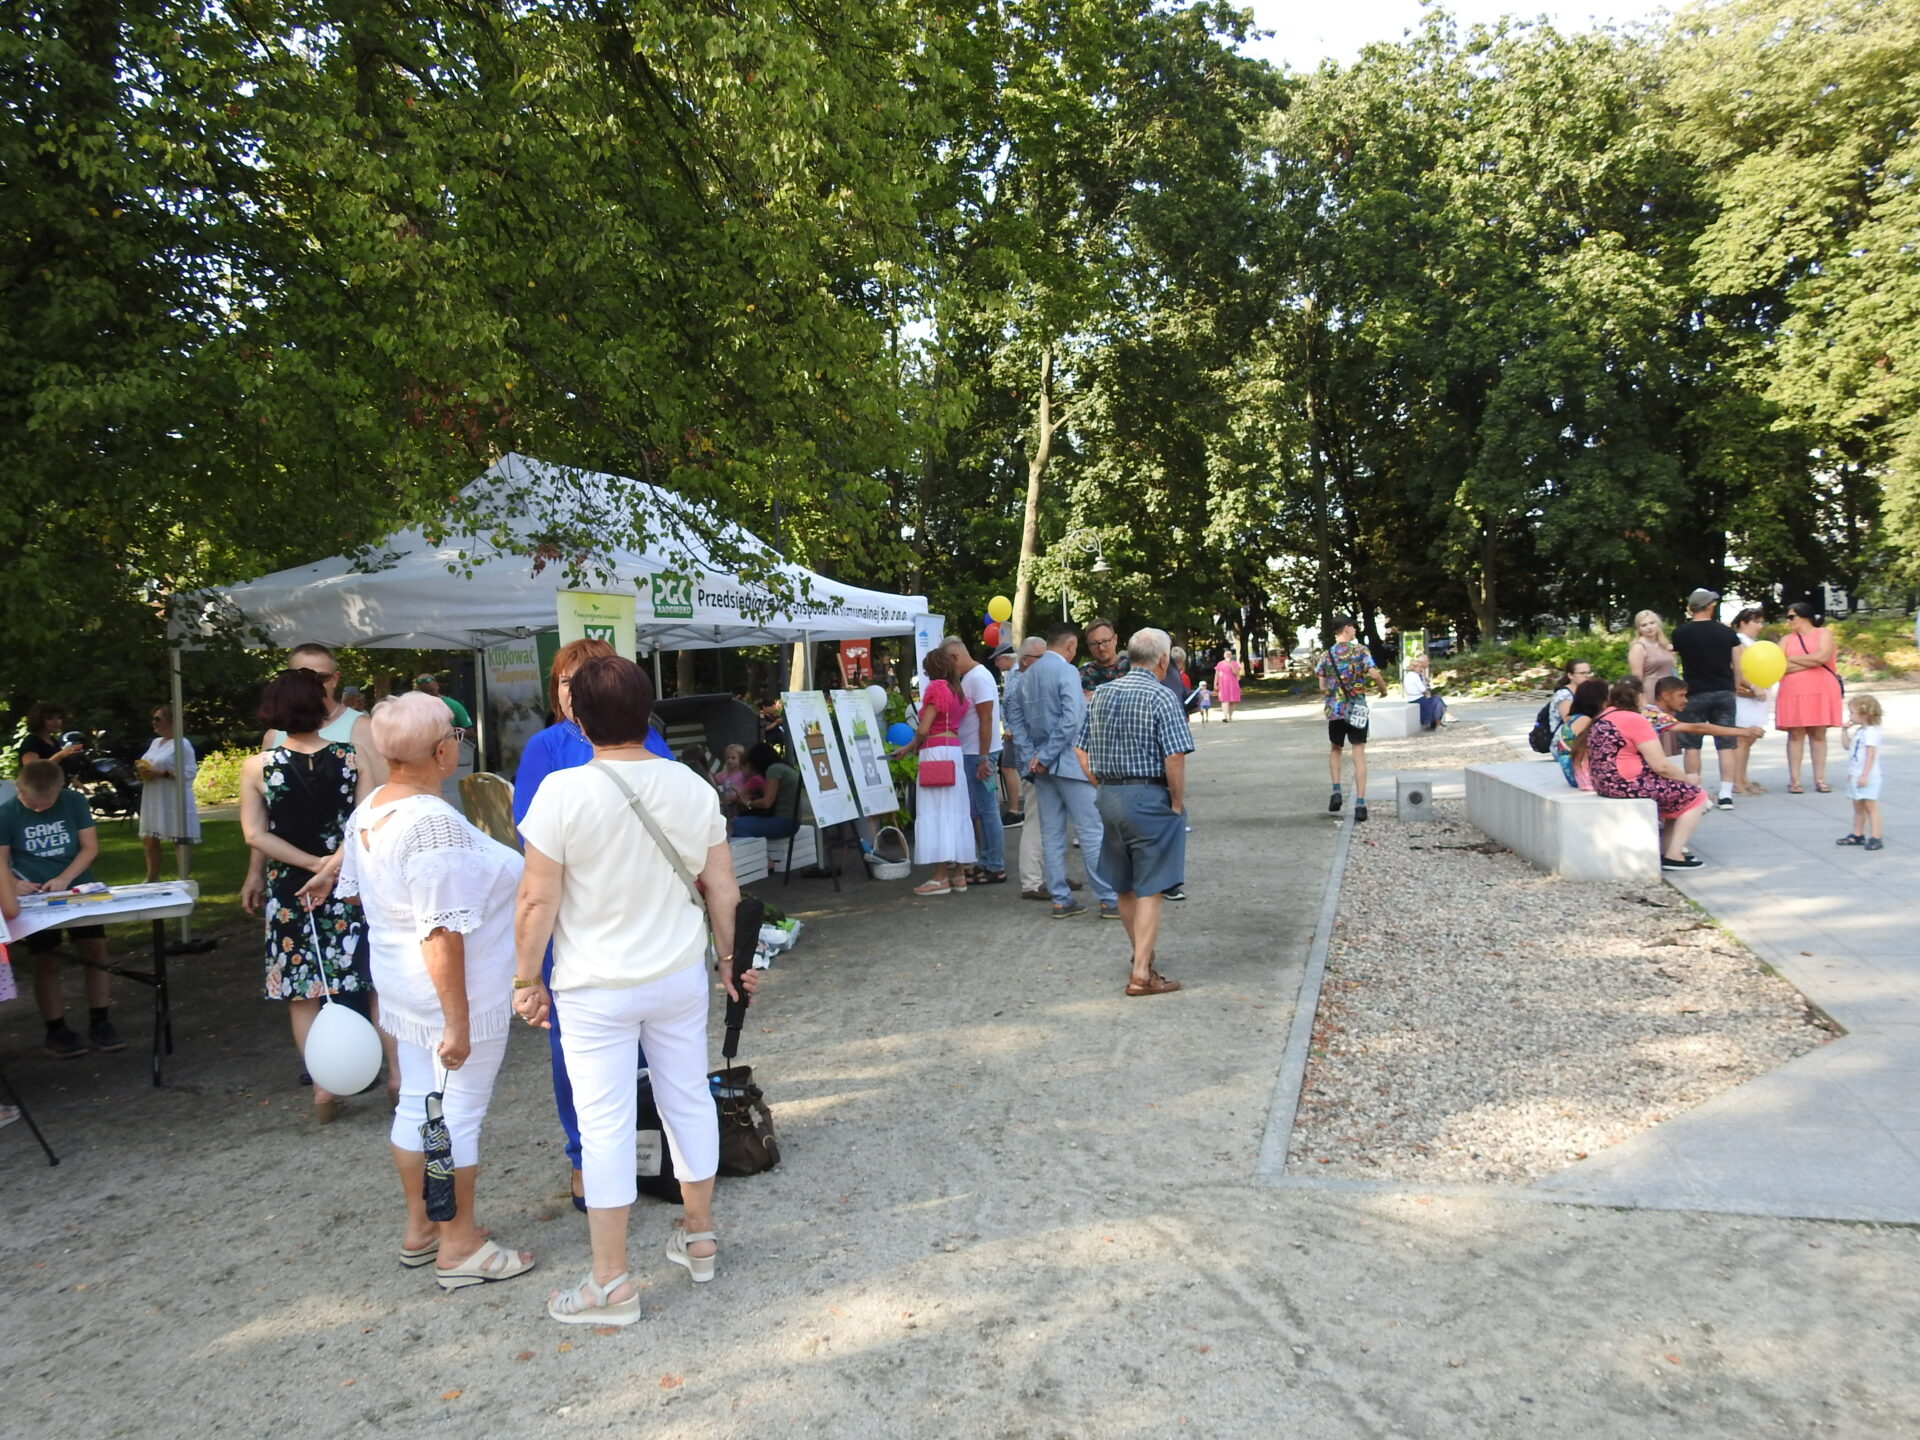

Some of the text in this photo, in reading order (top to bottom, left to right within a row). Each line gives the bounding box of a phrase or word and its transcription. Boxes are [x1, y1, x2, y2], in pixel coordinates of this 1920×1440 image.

[654, 577, 690, 605] PGK
[24, 820, 66, 839] GAME
[25, 832, 71, 851] OVER
